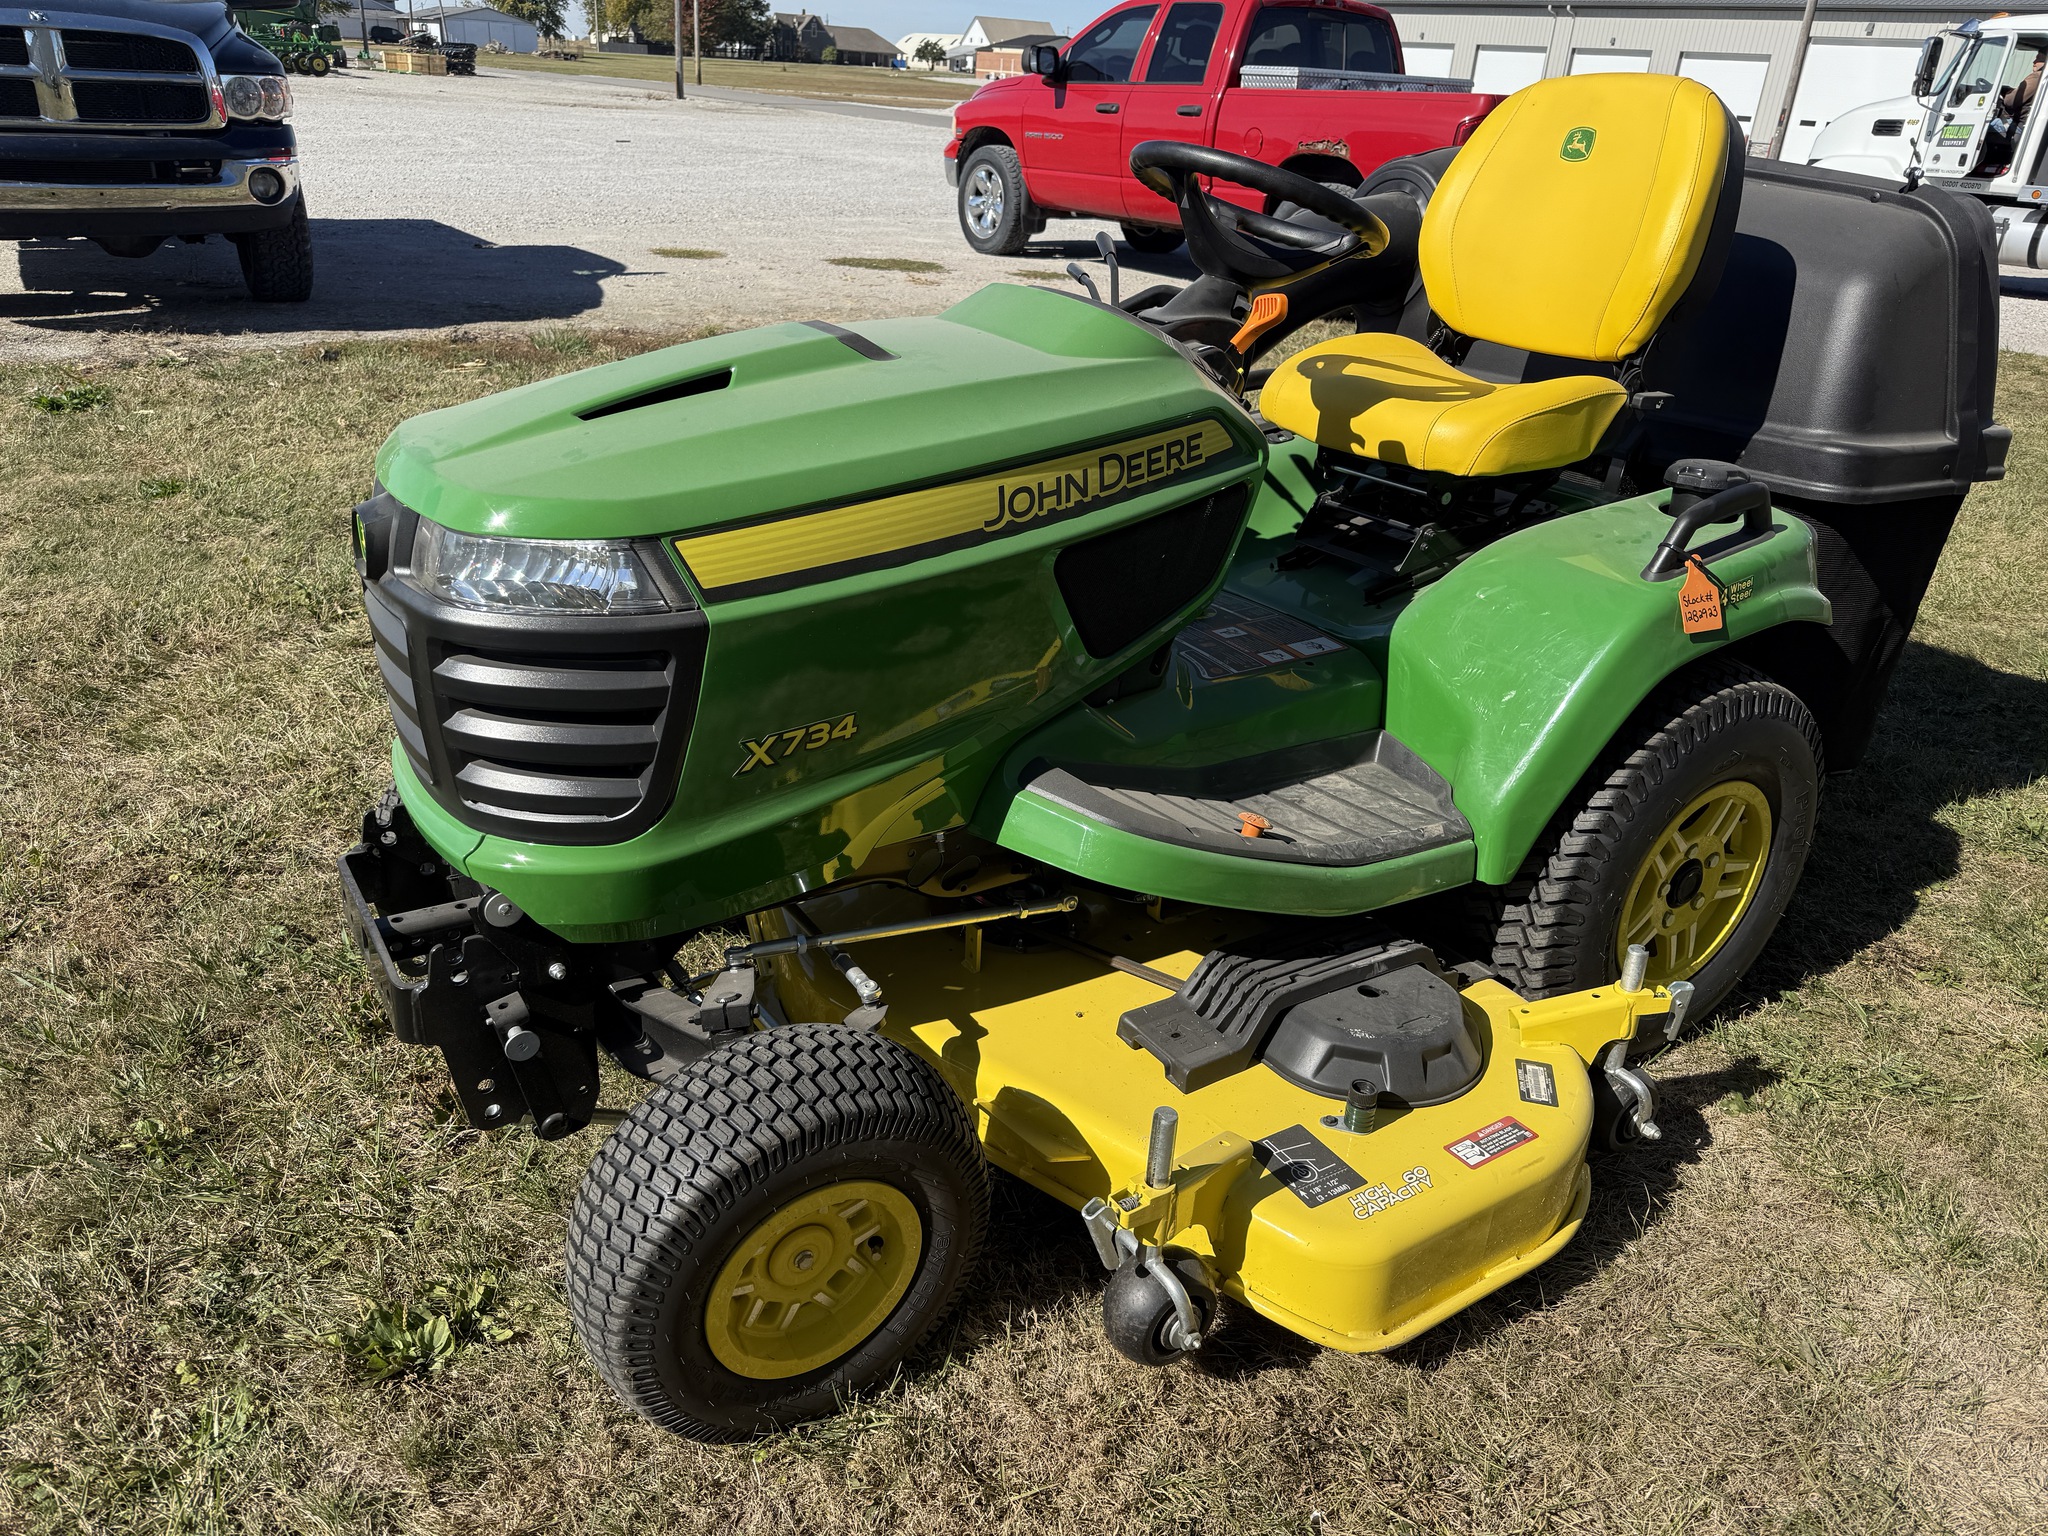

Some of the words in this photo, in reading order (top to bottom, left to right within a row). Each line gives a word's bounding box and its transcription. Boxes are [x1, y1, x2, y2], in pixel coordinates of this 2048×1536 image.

[983, 467, 1091, 531] JOHN
[1097, 431, 1206, 497] DEERE
[1730, 577, 1754, 592] Wheel
[1730, 588, 1753, 604] Steer
[1684, 606, 1718, 622] 1282923
[739, 714, 858, 774] X734
[1402, 1166, 1429, 1184] 60
[1349, 1182, 1391, 1208] HIGH
[1353, 1175, 1434, 1220] CAPACITY
